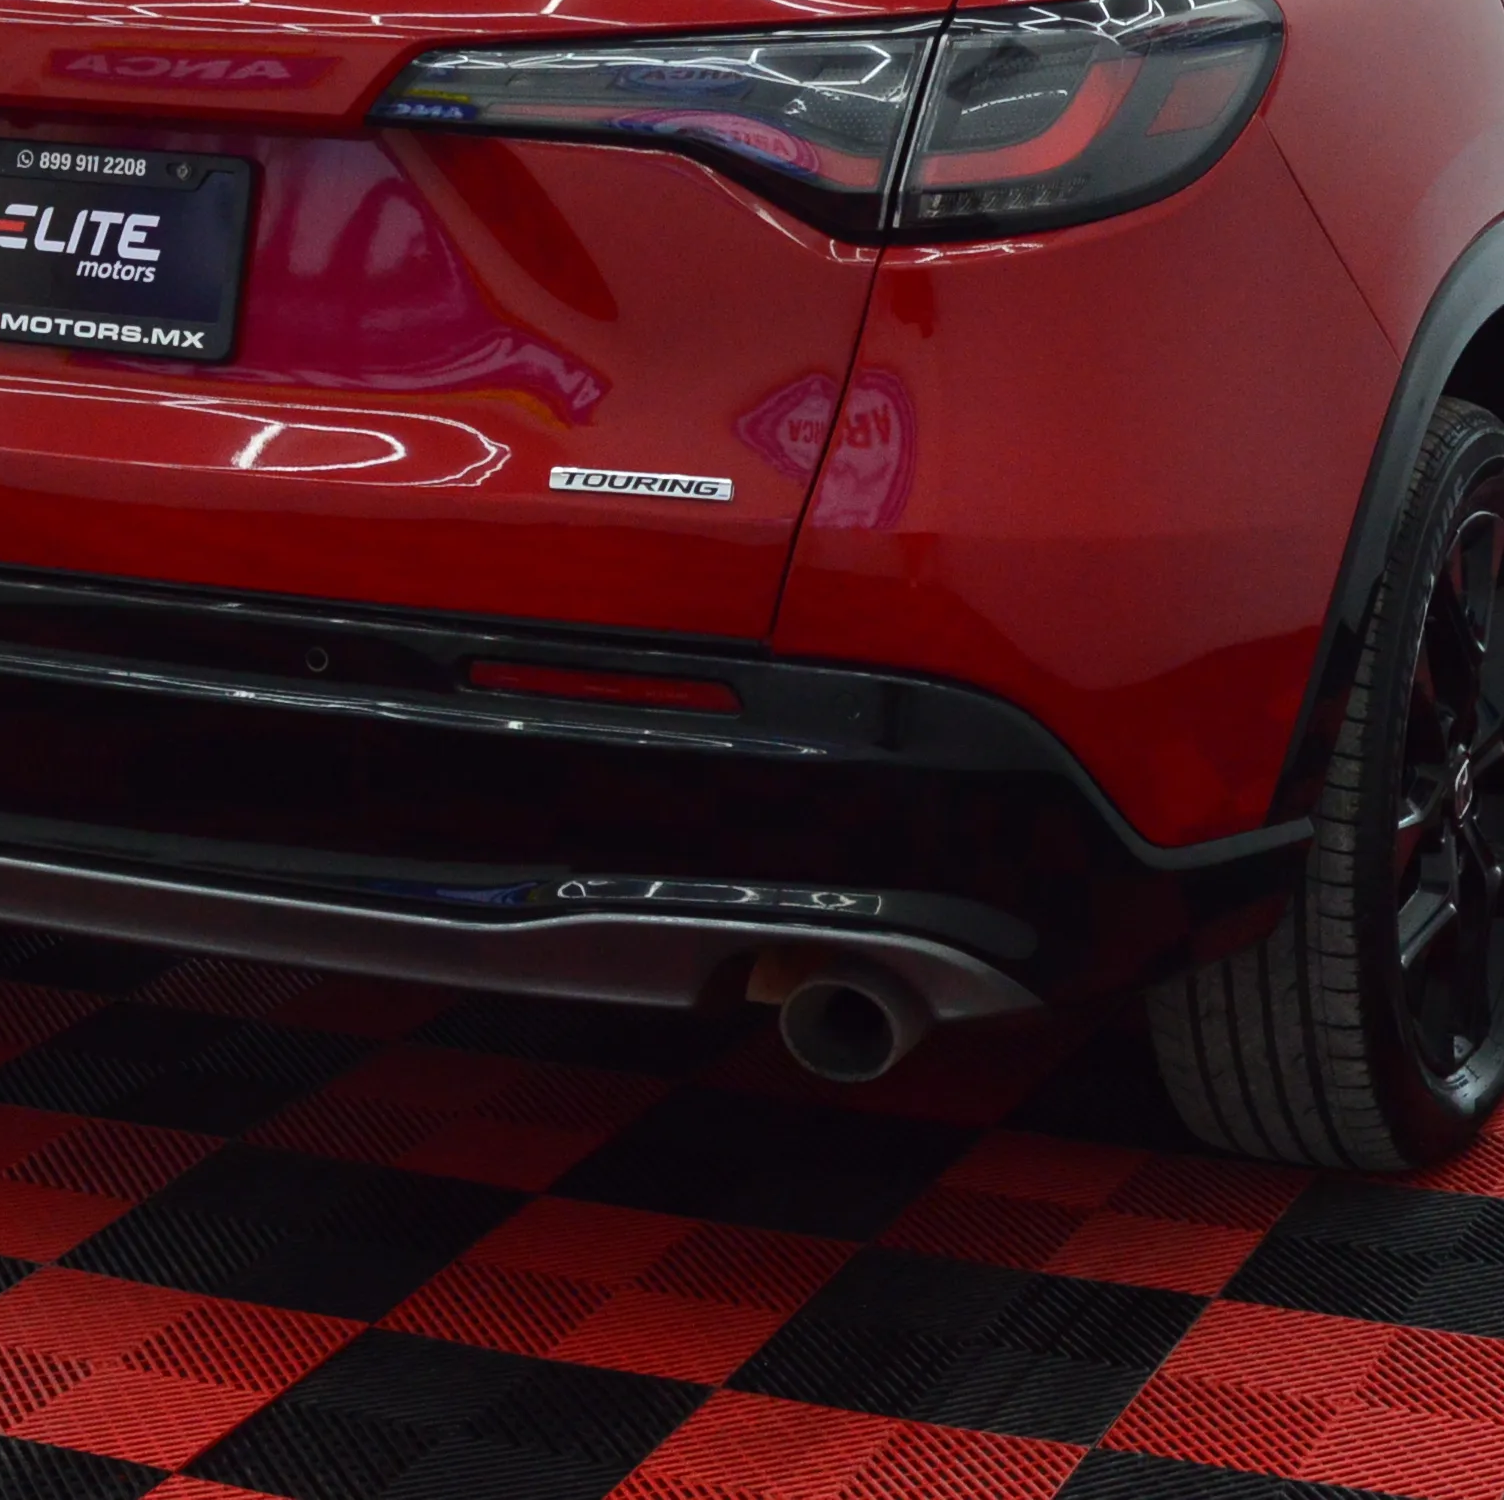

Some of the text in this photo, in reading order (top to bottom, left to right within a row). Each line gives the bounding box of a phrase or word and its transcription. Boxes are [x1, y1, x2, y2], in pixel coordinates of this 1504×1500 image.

[39, 151, 147, 177] 899 911 2208
[75, 259, 156, 283] motors
[561, 471, 721, 497] TOURING
